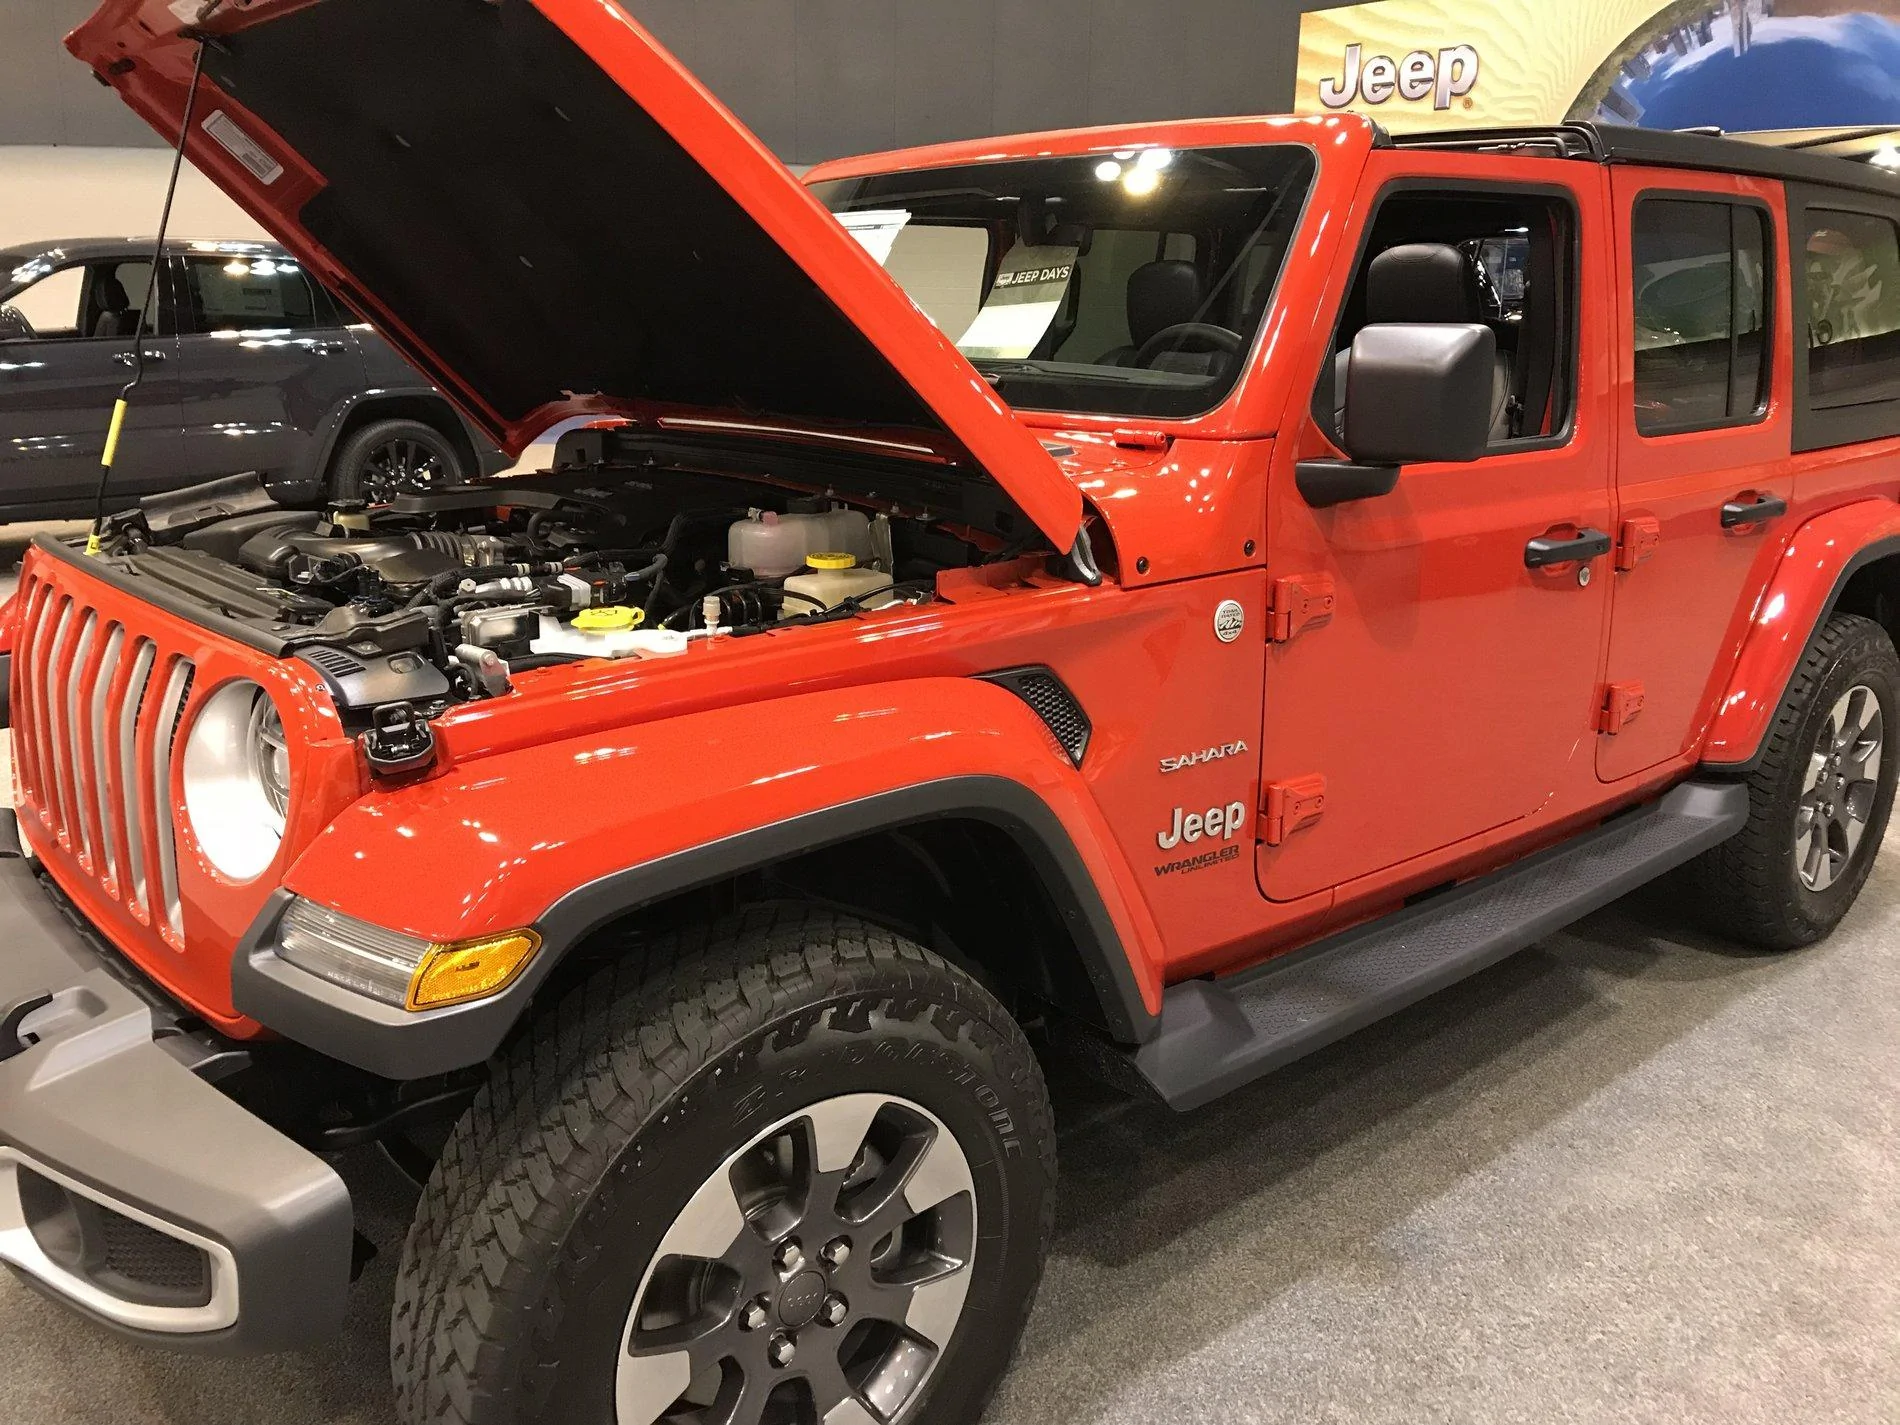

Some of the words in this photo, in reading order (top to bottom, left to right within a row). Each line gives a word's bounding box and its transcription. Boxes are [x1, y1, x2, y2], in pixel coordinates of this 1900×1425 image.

[1319, 43, 1480, 110] Jeep
[1011, 270, 1040, 284] JEEP
[1040, 265, 1070, 281] DAYS
[1159, 740, 1249, 772] SAHARA
[1157, 801, 1246, 849] Jeep
[1154, 844, 1240, 876] WRANGLER
[1181, 853, 1240, 875] UNLIMITED
